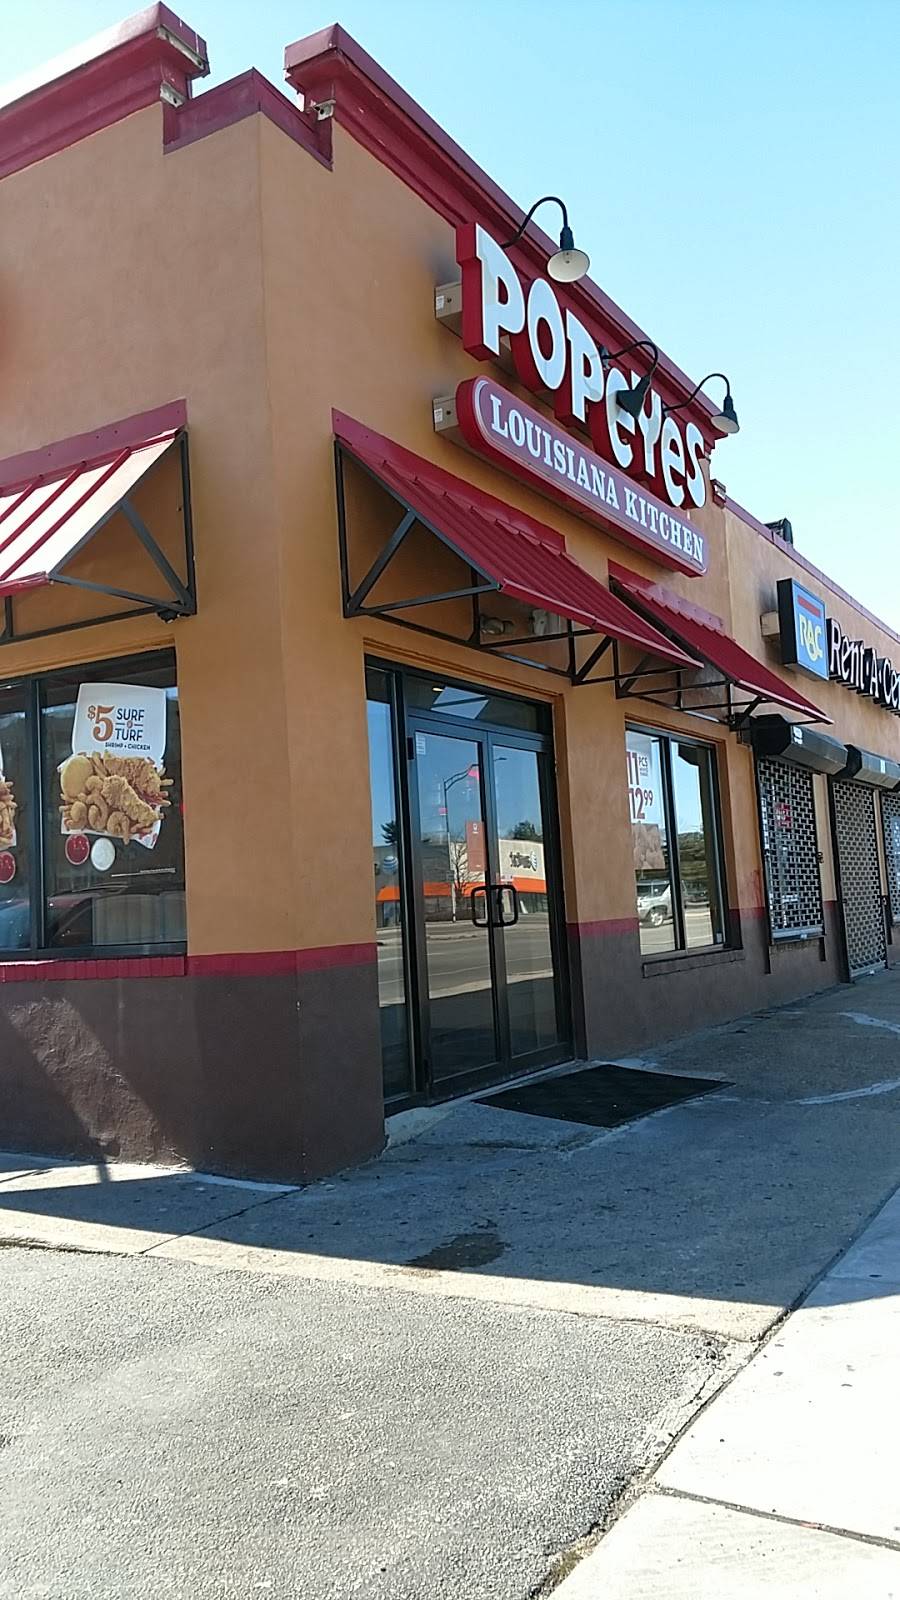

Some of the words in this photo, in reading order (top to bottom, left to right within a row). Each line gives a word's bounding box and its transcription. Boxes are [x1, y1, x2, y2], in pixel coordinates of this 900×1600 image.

[489, 393, 620, 511] LOUISIANA
[623, 486, 704, 565] KITCHEN
[798, 612, 824, 663] RAC
[87, 704, 115, 742] $5
[116, 708, 145, 722] SURF
[114, 728, 144, 742] TURF
[127, 743, 151, 751] CHICKEN
